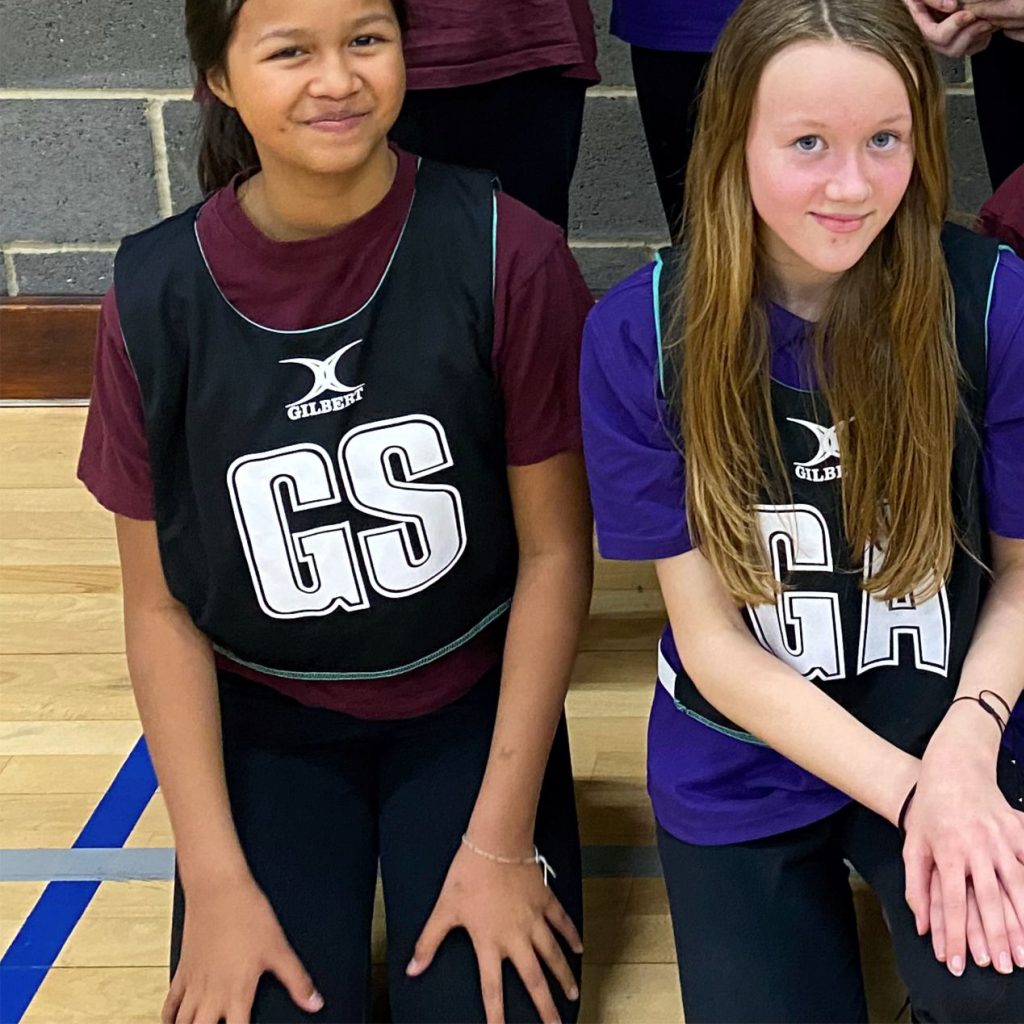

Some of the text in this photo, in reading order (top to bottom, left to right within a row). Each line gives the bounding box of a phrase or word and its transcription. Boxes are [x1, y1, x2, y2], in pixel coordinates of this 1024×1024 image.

[287, 386, 364, 421] GILBERT
[226, 413, 467, 619] GS
[795, 465, 843, 482] GILB
[746, 503, 951, 681] GA
